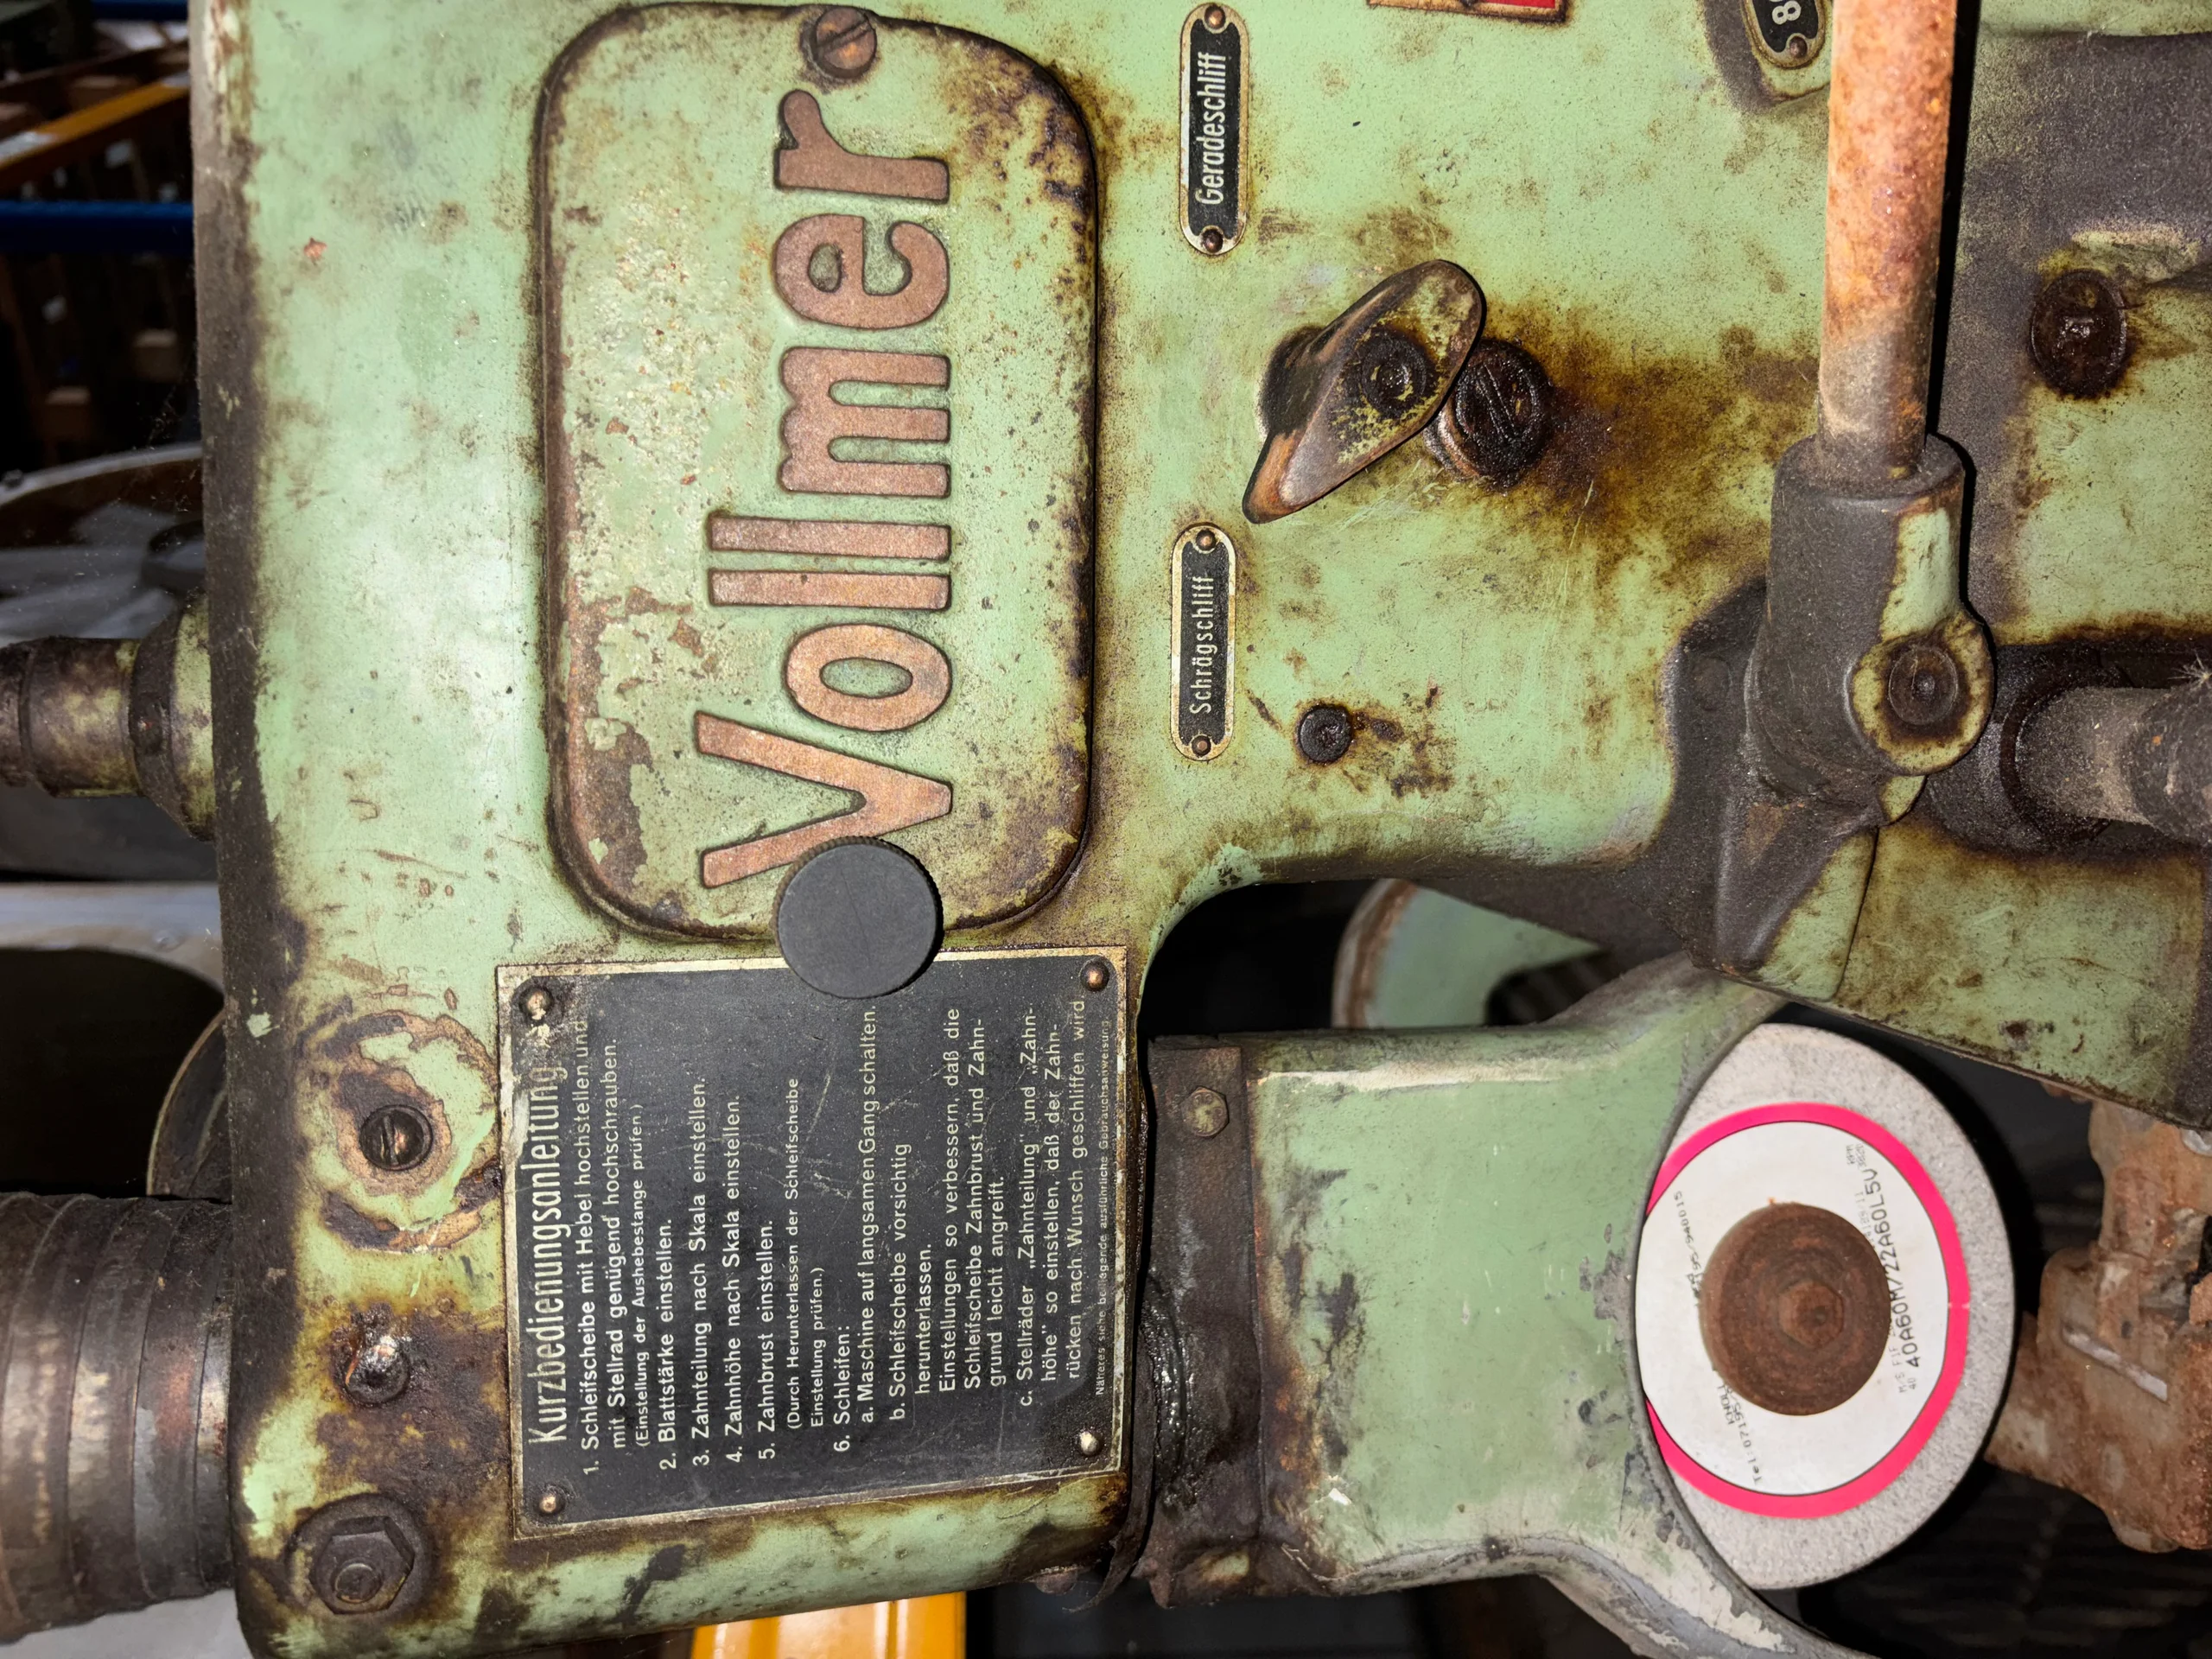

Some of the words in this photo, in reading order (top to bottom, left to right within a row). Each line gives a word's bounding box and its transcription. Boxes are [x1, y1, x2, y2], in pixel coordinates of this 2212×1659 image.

[1771, 0, 1801, 25] 8
[1195, 51, 1227, 206] Geradeschliff
[694, 88, 952, 887] Vollmer
[1189, 575, 1217, 715] Schrägschliff
[573, 1020, 588, 1057] und
[859, 1006, 876, 1095] schalten.
[944, 1009, 959, 1039] die
[969, 1019, 985, 1076] Zahn-
[1045, 1025, 1061, 1080] Zahn-
[944, 1051, 959, 1086] daß
[573, 1065, 592, 1185] hochstellen
[601, 1039, 619, 1205] hochschrauben.
[630, 1104, 645, 1170] prüfen.)
[688, 1077, 706, 1183] einstellen.
[859, 1101, 880, 1154] Gang
[969, 1089, 983, 1123] und
[1020, 1087, 1036, 1122] und
[1045, 1090, 1060, 1123] der
[1068, 1052, 1089, 1159] geschliffen
[722, 1096, 741, 1199] einstellen.
[785, 1079, 798, 1199] Schleifscheibe
[942, 1097, 961, 1213] verbessern,
[1044, 1135, 1060, 1170] daß
[857, 1157, 878, 1265] langsamen
[891, 1144, 910, 1241] vorsichtig
[966, 1135, 983, 1233] Zahnbrust
[988, 1177, 1007, 1256] angreift.
[1066, 1170, 1084, 1247] Wunsch
[521, 1067, 569, 1443] Kurzbedienungsanleitung
[575, 1193, 594, 1254] Hebel
[631, 1180, 646, 1306] Aushebestange
[688, 1194, 706, 1251] Skala
[722, 1211, 741, 1268] Skala
[785, 1209, 798, 1236] der
[945, 1225, 958, 1247] so
[1043, 1180, 1060, 1280] einstellen,
[577, 1262, 594, 1293] mit
[602, 1217, 627, 1318] genügend
[655, 1218, 673, 1322] einstellen.
[689, 1263, 707, 1310] nach
[756, 1220, 773, 1322] einstellen.
[809, 1268, 826, 1330] prüfen.)
[857, 1272, 874, 1301] auf
[987, 1268, 1003, 1320] leicht
[1065, 1259, 1083, 1303] nach
[632, 1316, 646, 1343] der
[723, 1279, 741, 1326] nach
[785, 1245, 798, 1368] Herunterlassen
[888, 1253, 906, 1397] Schleifscheibe
[915, 1244, 932, 1394] herunterlassen.
[940, 1259, 960, 1391] Einstellungen
[964, 1245, 982, 1389] Schleifscheibe
[1018, 1286, 1035, 1380] Stellräder
[1046, 1292, 1058, 1313] so
[578, 1301, 599, 1450] Schleifscheibe
[606, 1330, 626, 1407] Stellrad
[833, 1325, 850, 1425] Schleifen:
[857, 1307, 874, 1401] Maschine
[988, 1332, 1007, 1386] grund
[1065, 1315, 1082, 1379] rücken
[634, 1351, 650, 1447] (Einstellung
[658, 1334, 676, 1442] Blattstärke
[690, 1323, 711, 1439] Zahnteilung
[723, 1338, 742, 1436] Zahnhöhe
[757, 1333, 774, 1433] Zahnbrust
[786, 1376, 803, 1429] (Durch
[810, 1339, 826, 1427] Einstellung
[889, 1403, 906, 1420] b.
[1020, 1391, 1033, 1406] c.
[609, 1417, 626, 1448] mit
[835, 1435, 850, 1452] 6.
[860, 1407, 874, 1422] a.
[583, 1461, 599, 1475] 1.
[659, 1453, 677, 1469] 2.
[693, 1450, 709, 1465] 3.
[727, 1446, 742, 1462] 4.
[760, 1443, 775, 1459] 5.
